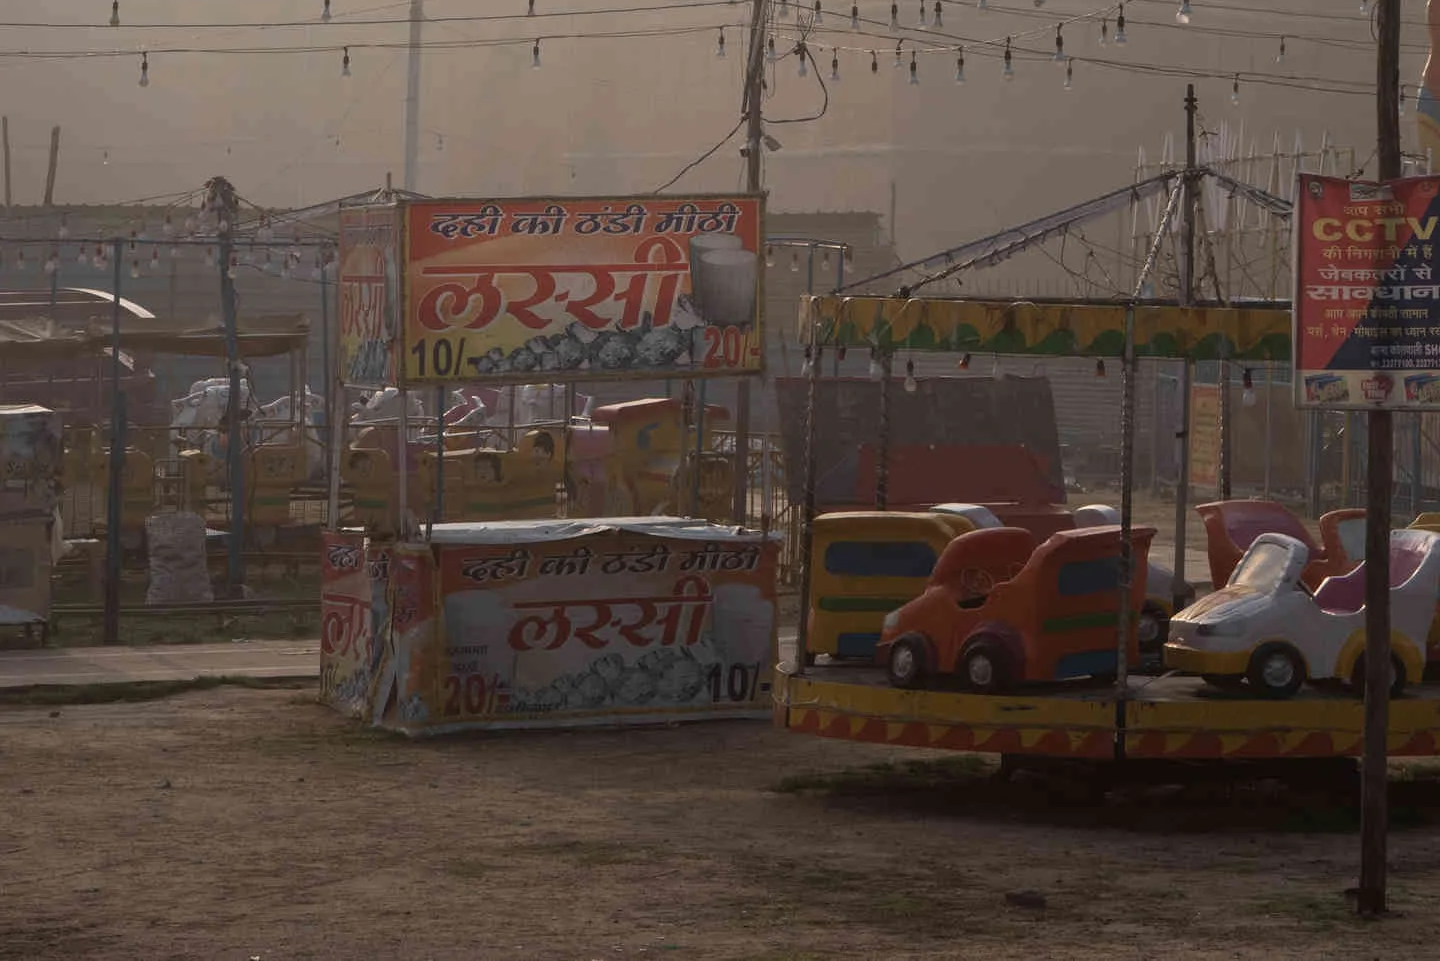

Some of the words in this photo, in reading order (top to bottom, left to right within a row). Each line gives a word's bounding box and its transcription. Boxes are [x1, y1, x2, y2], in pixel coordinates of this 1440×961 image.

[431, 204, 504, 237] दही
[511, 204, 569, 235] की
[574, 203, 648, 235] ठंडी
[655, 202, 742, 234] मीठी
[1344, 205, 1369, 216] आप
[1374, 202, 1405, 216] सभी
[1312, 216, 1439, 242] CCTV
[1321, 245, 1343, 260] की
[1404, 244, 1419, 258] में
[417, 237, 690, 330] लस्सी
[1317, 263, 1408, 281] जेबकतरों
[1411, 263, 1433, 280] से
[703, 325, 760, 369] 20/-
[460, 550, 530, 582] दही
[539, 548, 595, 576] की
[601, 544, 672, 575] ठंडी
[680, 543, 761, 572] मीठी
[508, 575, 713, 652] लस्सी
[709, 660, 771, 704] 10/-
